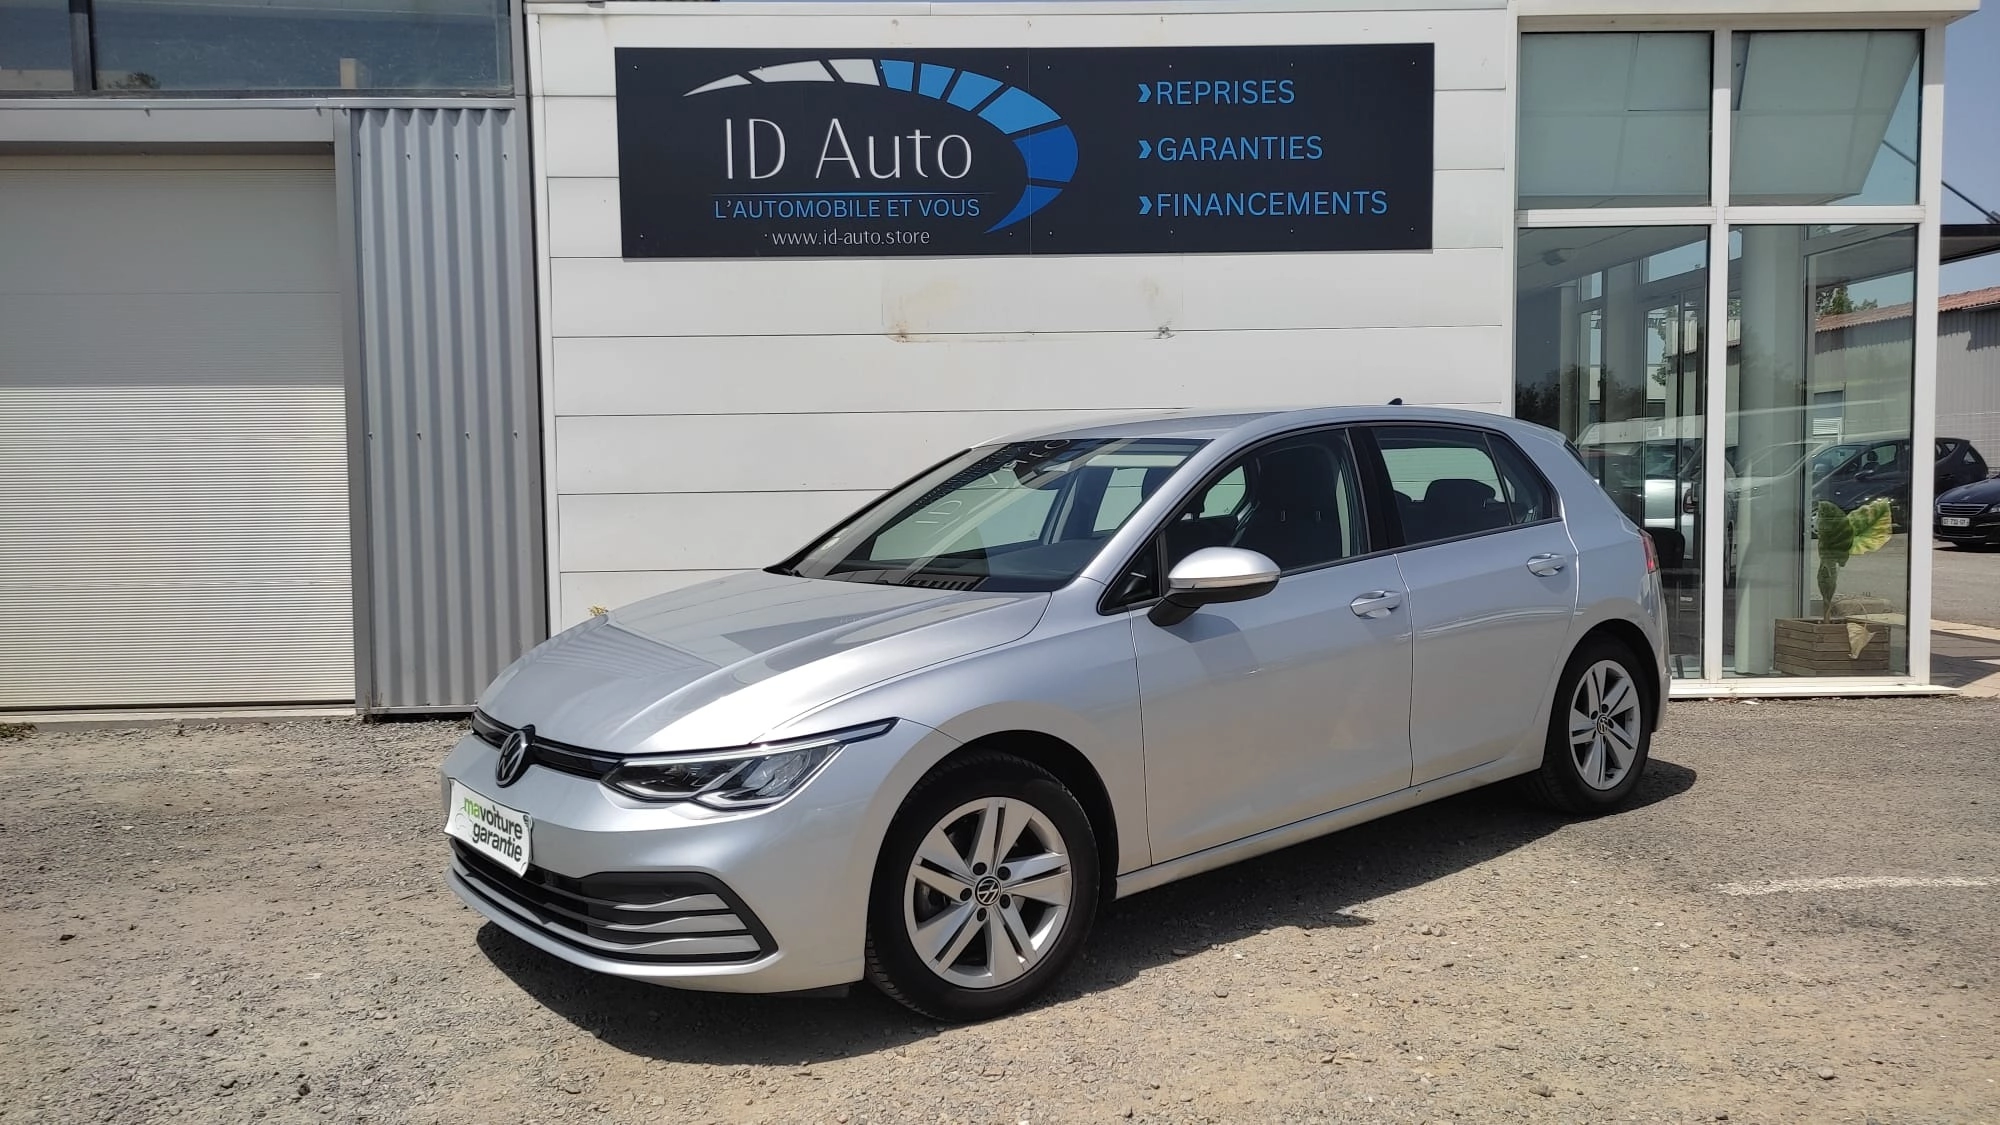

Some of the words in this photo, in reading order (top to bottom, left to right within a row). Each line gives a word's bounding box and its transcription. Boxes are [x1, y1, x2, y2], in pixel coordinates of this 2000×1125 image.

[1156, 79, 1295, 105] REPRISES
[725, 118, 786, 180] ID
[815, 117, 973, 180] Auto
[1157, 135, 1323, 162] GARANTIES
[887, 199, 913, 217] ET
[918, 198, 980, 218] VOUS
[1156, 190, 1388, 217] FINANCEMENTS
[772, 227, 931, 246] www.id-auto.store
[472, 822, 523, 862] garantie
